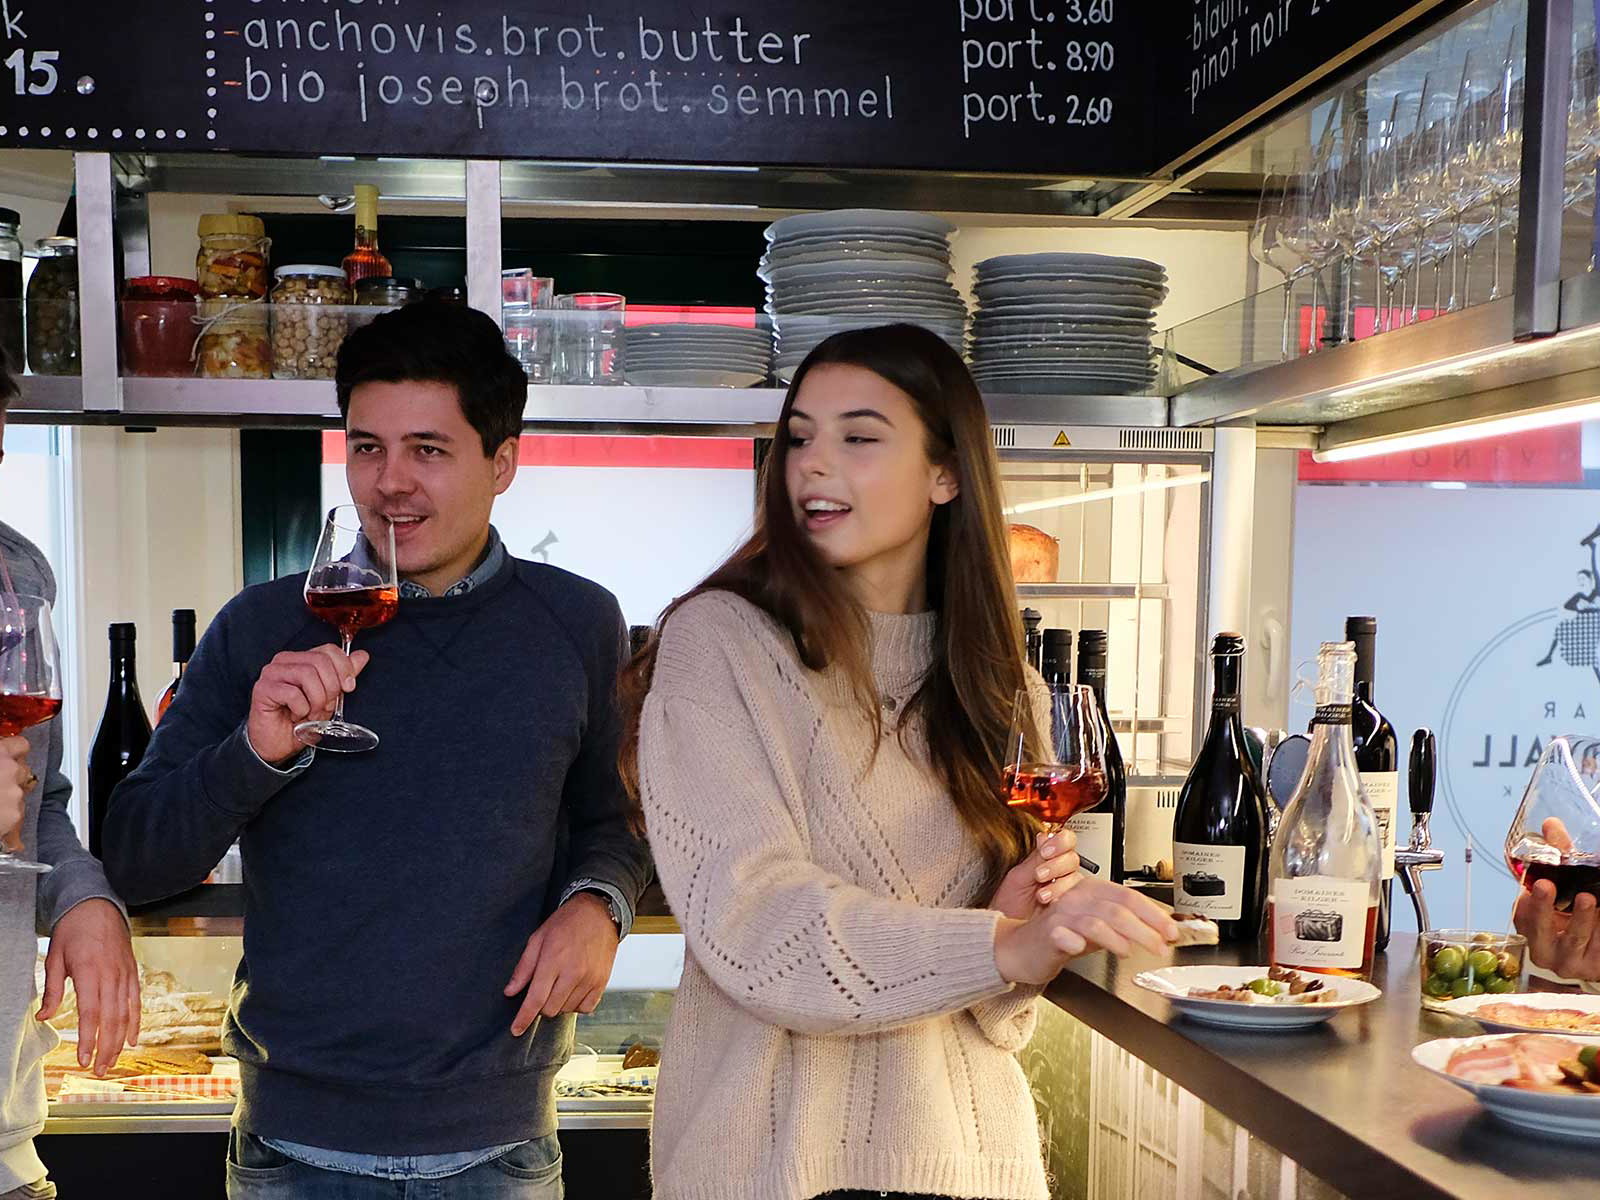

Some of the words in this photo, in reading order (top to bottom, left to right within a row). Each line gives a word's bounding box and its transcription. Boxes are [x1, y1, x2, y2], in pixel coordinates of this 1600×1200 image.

[963, 28, 1057, 84] port.
[1191, 30, 1239, 114] pinot
[1250, 0, 1295, 55] noir
[245, 57, 325, 103] bio
[356, 62, 530, 129] joseph
[963, 81, 1057, 138] port.
